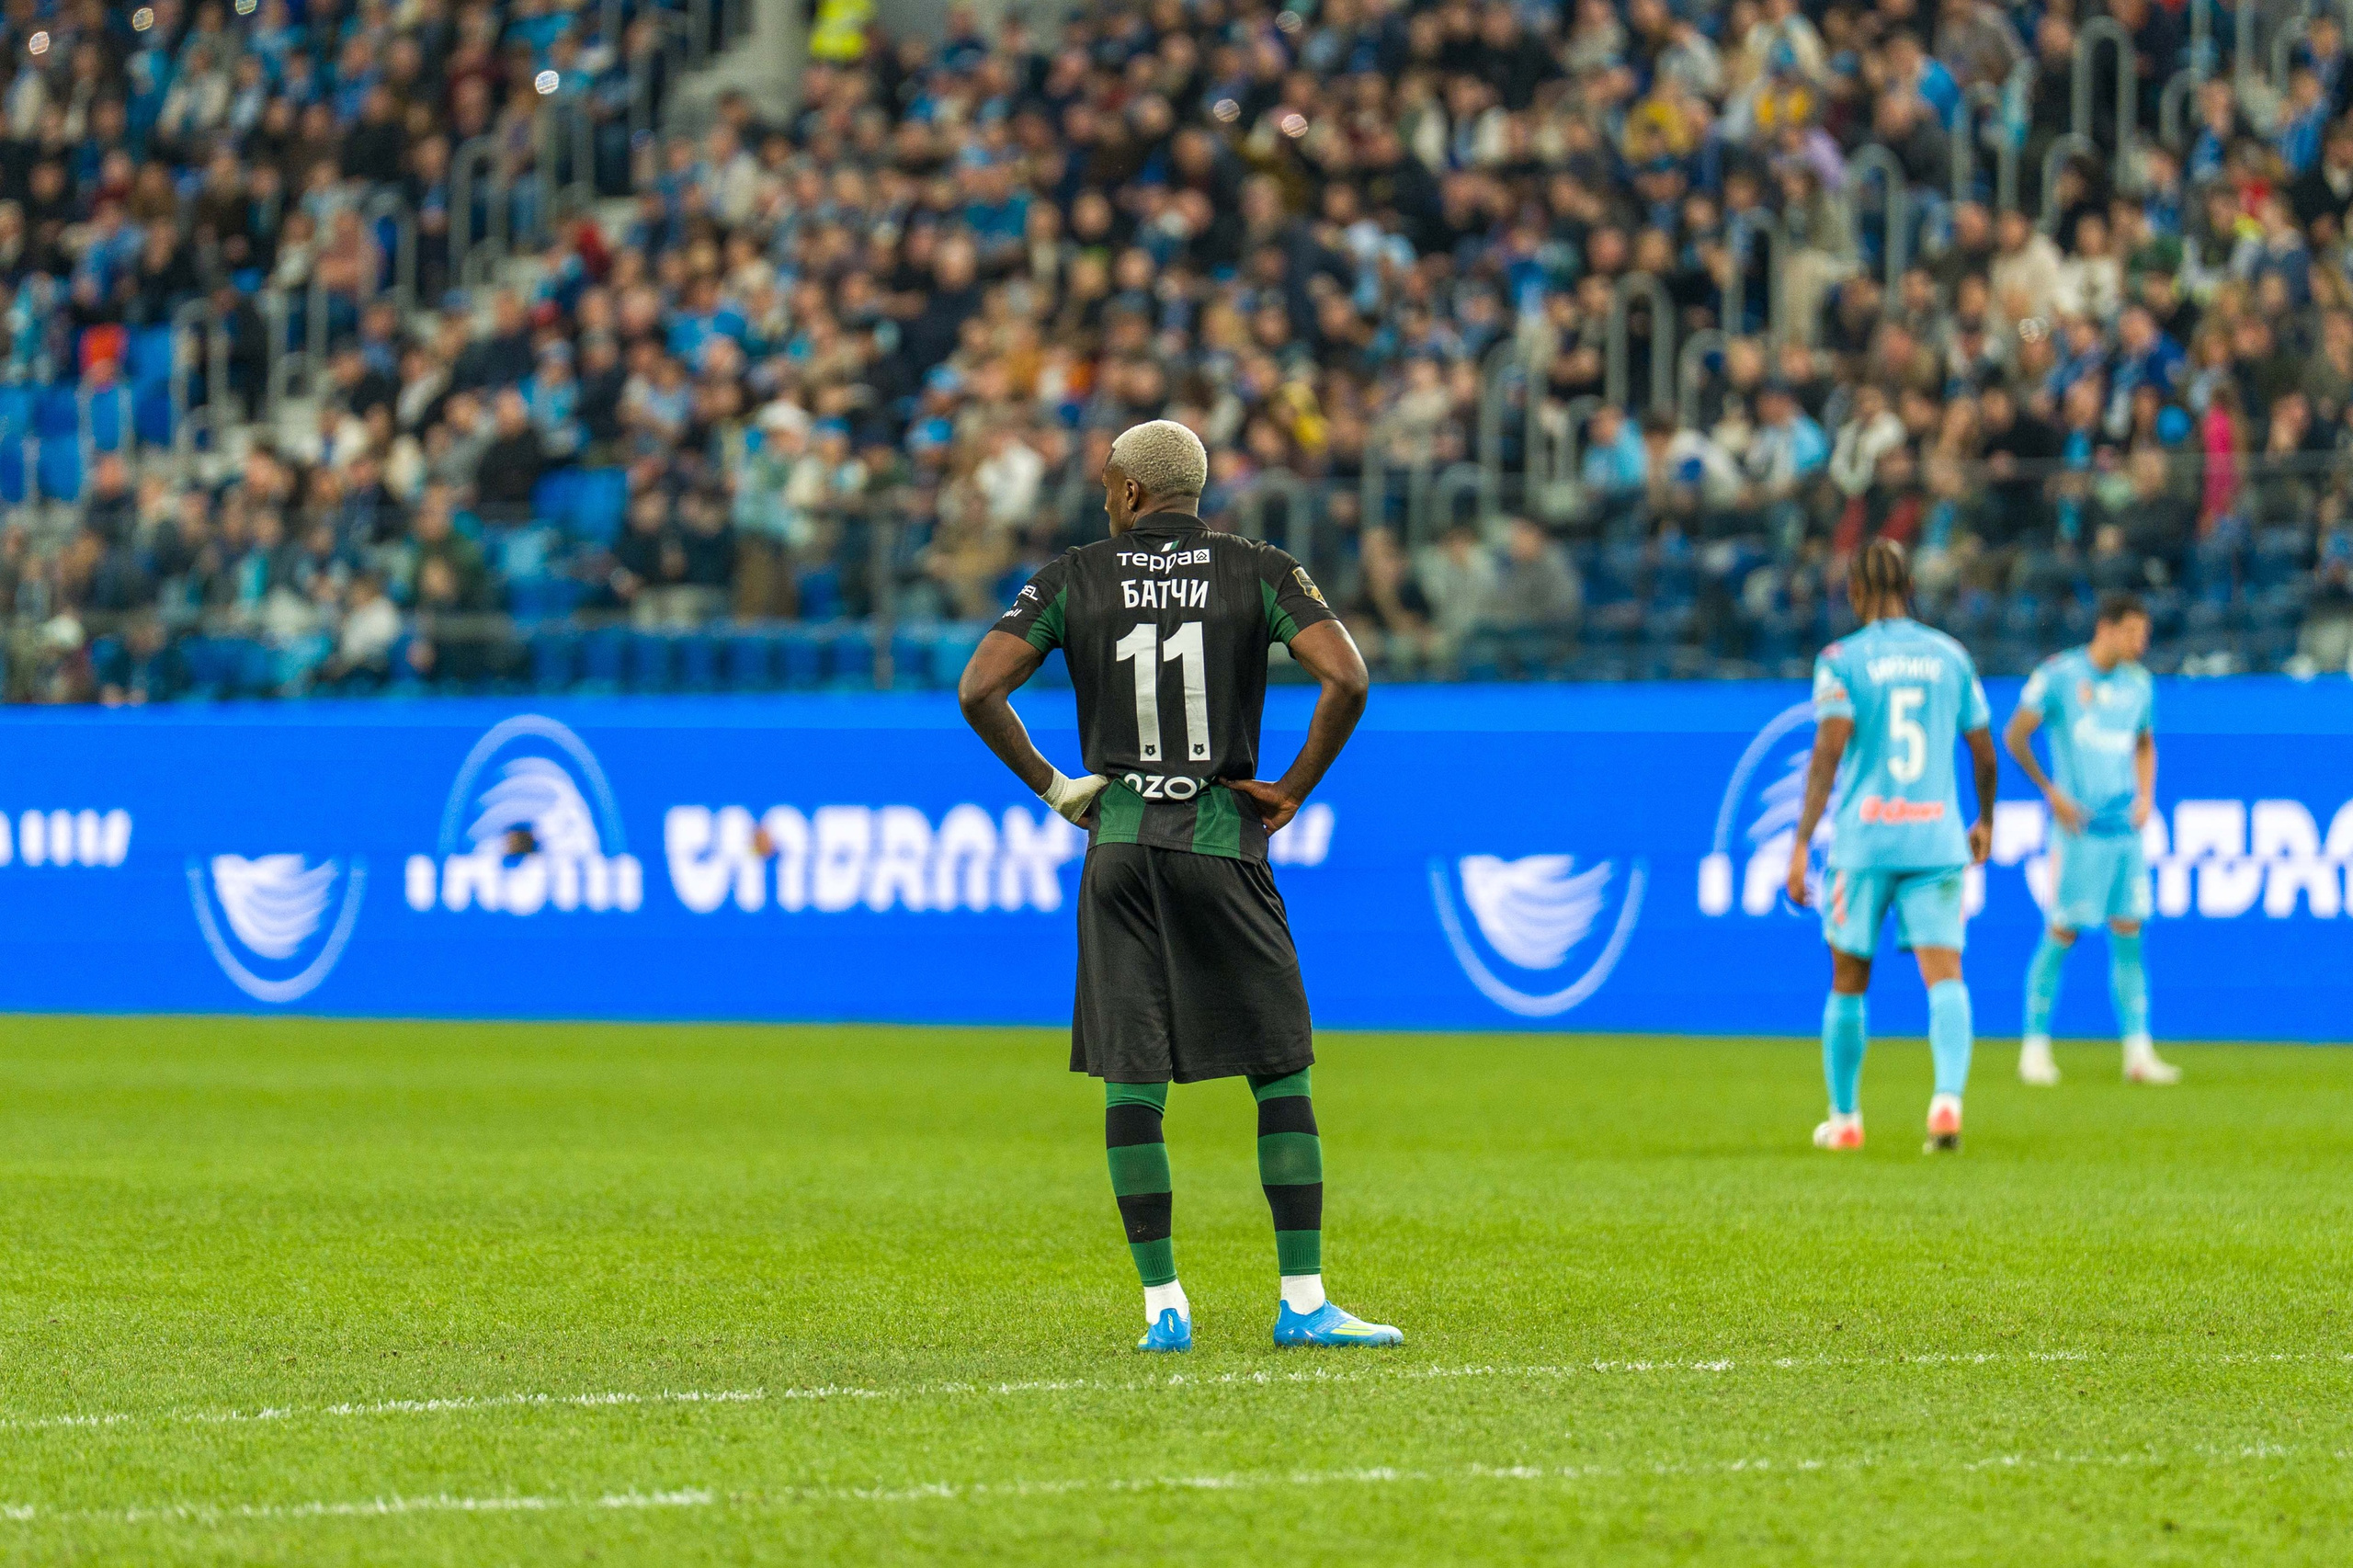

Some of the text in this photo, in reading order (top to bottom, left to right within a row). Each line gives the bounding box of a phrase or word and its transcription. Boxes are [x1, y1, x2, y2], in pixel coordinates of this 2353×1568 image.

[1120, 578, 1210, 609] БАТЧИ
[1116, 621, 1211, 761] 11
[1888, 687, 1927, 784] 5
[1123, 773, 1212, 801] OZO
